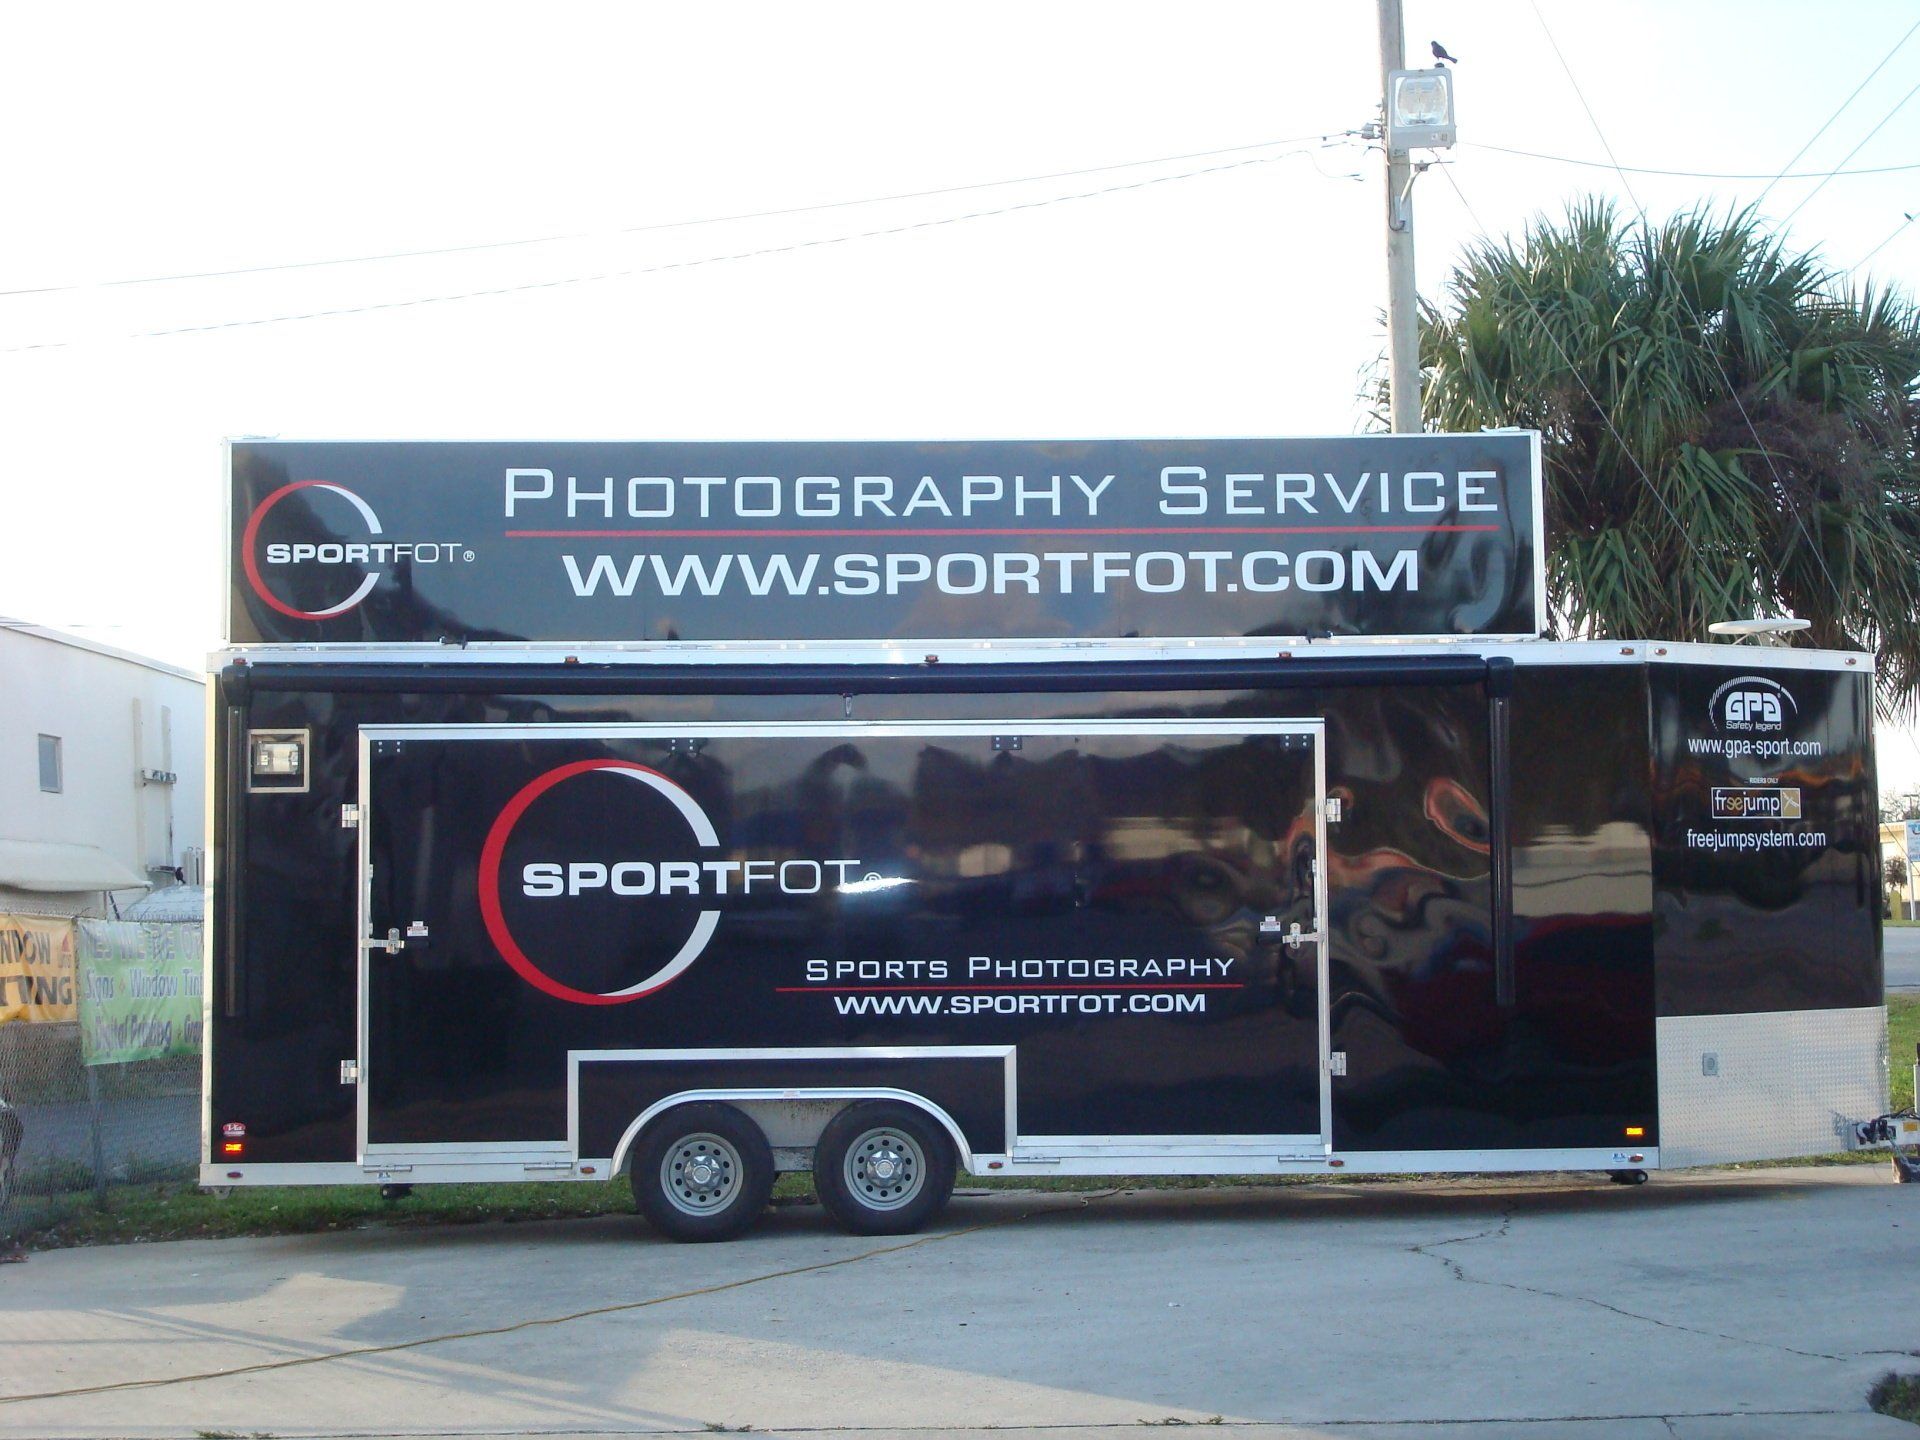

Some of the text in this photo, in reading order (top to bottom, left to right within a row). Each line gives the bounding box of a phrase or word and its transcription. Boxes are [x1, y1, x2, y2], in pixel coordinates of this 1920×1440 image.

[504, 465, 1498, 519] PHOTOGRAPHY SERVICE
[561, 549, 1420, 597] WWW.SPORTFOT.COM
[1725, 691, 1782, 721] GPA
[1726, 720, 1782, 731] Safety legend
[1687, 737, 1822, 759] www.gpa-sport.com
[1715, 789, 1780, 816] freejump
[1686, 828, 1827, 851] freejumpsystem.com
[805, 956, 1235, 981] SPORTS PHOTOGRAPHY
[129, 967, 179, 998] Window
